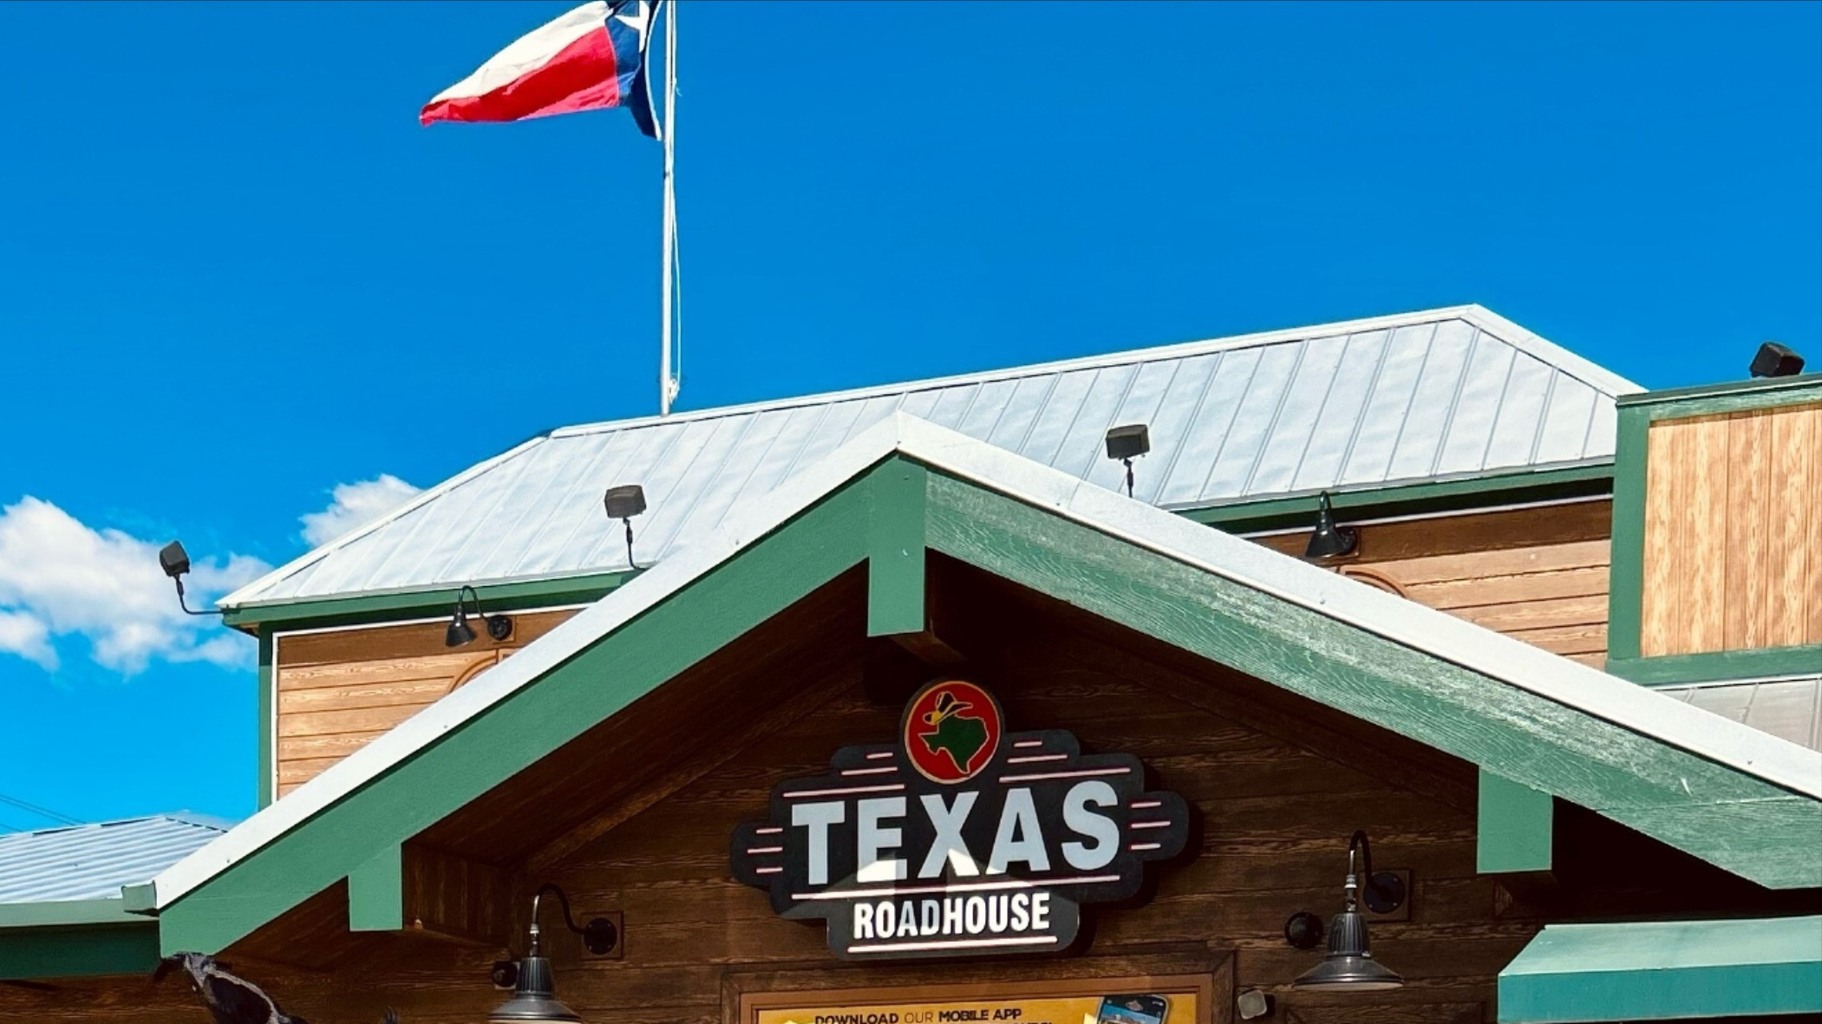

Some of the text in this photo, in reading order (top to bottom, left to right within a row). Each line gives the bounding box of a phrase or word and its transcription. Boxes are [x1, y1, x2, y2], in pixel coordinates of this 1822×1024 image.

[791, 780, 1120, 885] TEXAS
[853, 893, 1050, 939] ROADHOUSE
[904, 1011, 933, 1024] OUR
[938, 1009, 989, 1022] MOBILE
[993, 1008, 1022, 1020] APP
